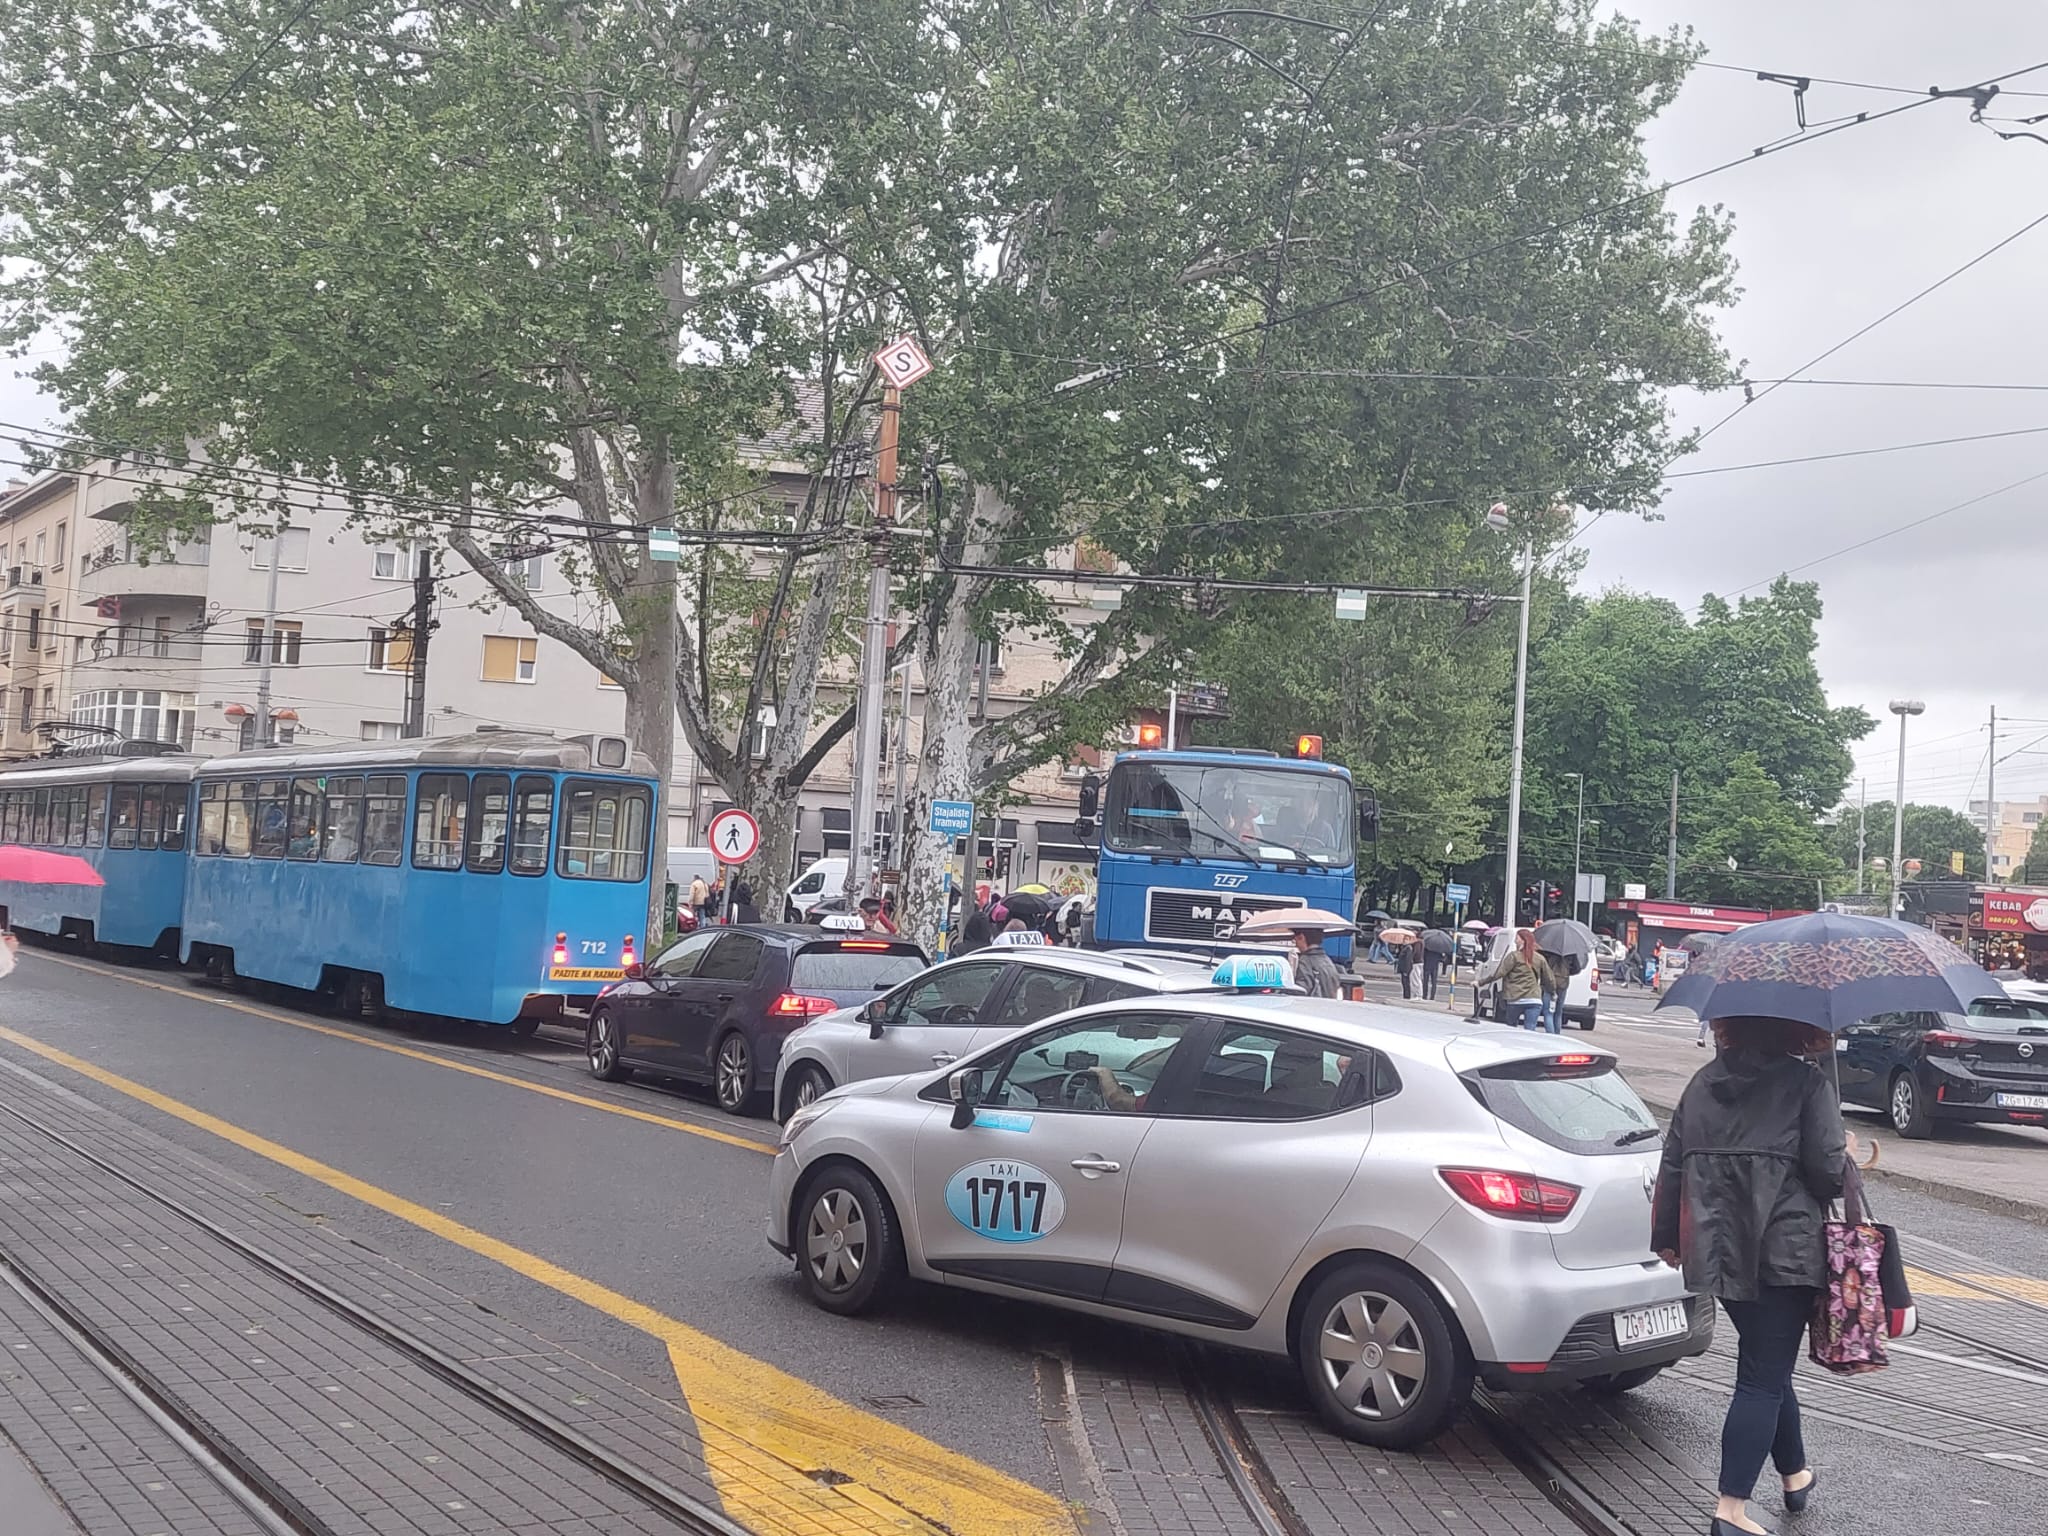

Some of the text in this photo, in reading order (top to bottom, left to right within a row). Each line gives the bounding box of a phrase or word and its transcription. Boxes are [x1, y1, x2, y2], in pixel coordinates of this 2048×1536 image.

[895, 352, 911, 372] S
[934, 818, 968, 829] tramvaja
[1213, 873, 1249, 888] ZET
[1689, 907, 1715, 917] TISAK
[1989, 900, 2022, 911] KEBAB
[1192, 906, 1263, 923] MAN
[834, 918, 859, 929] TAXI
[1011, 933, 1042, 945] TAXI
[581, 941, 607, 955] 712
[554, 969, 579, 978] PAZITE
[580, 970, 592, 978] NA
[1254, 962, 1276, 983] 1717
[2004, 1095, 2016, 1105] ZG
[989, 1164, 1019, 1177] TAXI
[966, 1177, 1047, 1234] 1717
[1622, 1313, 1640, 1339] ZG
